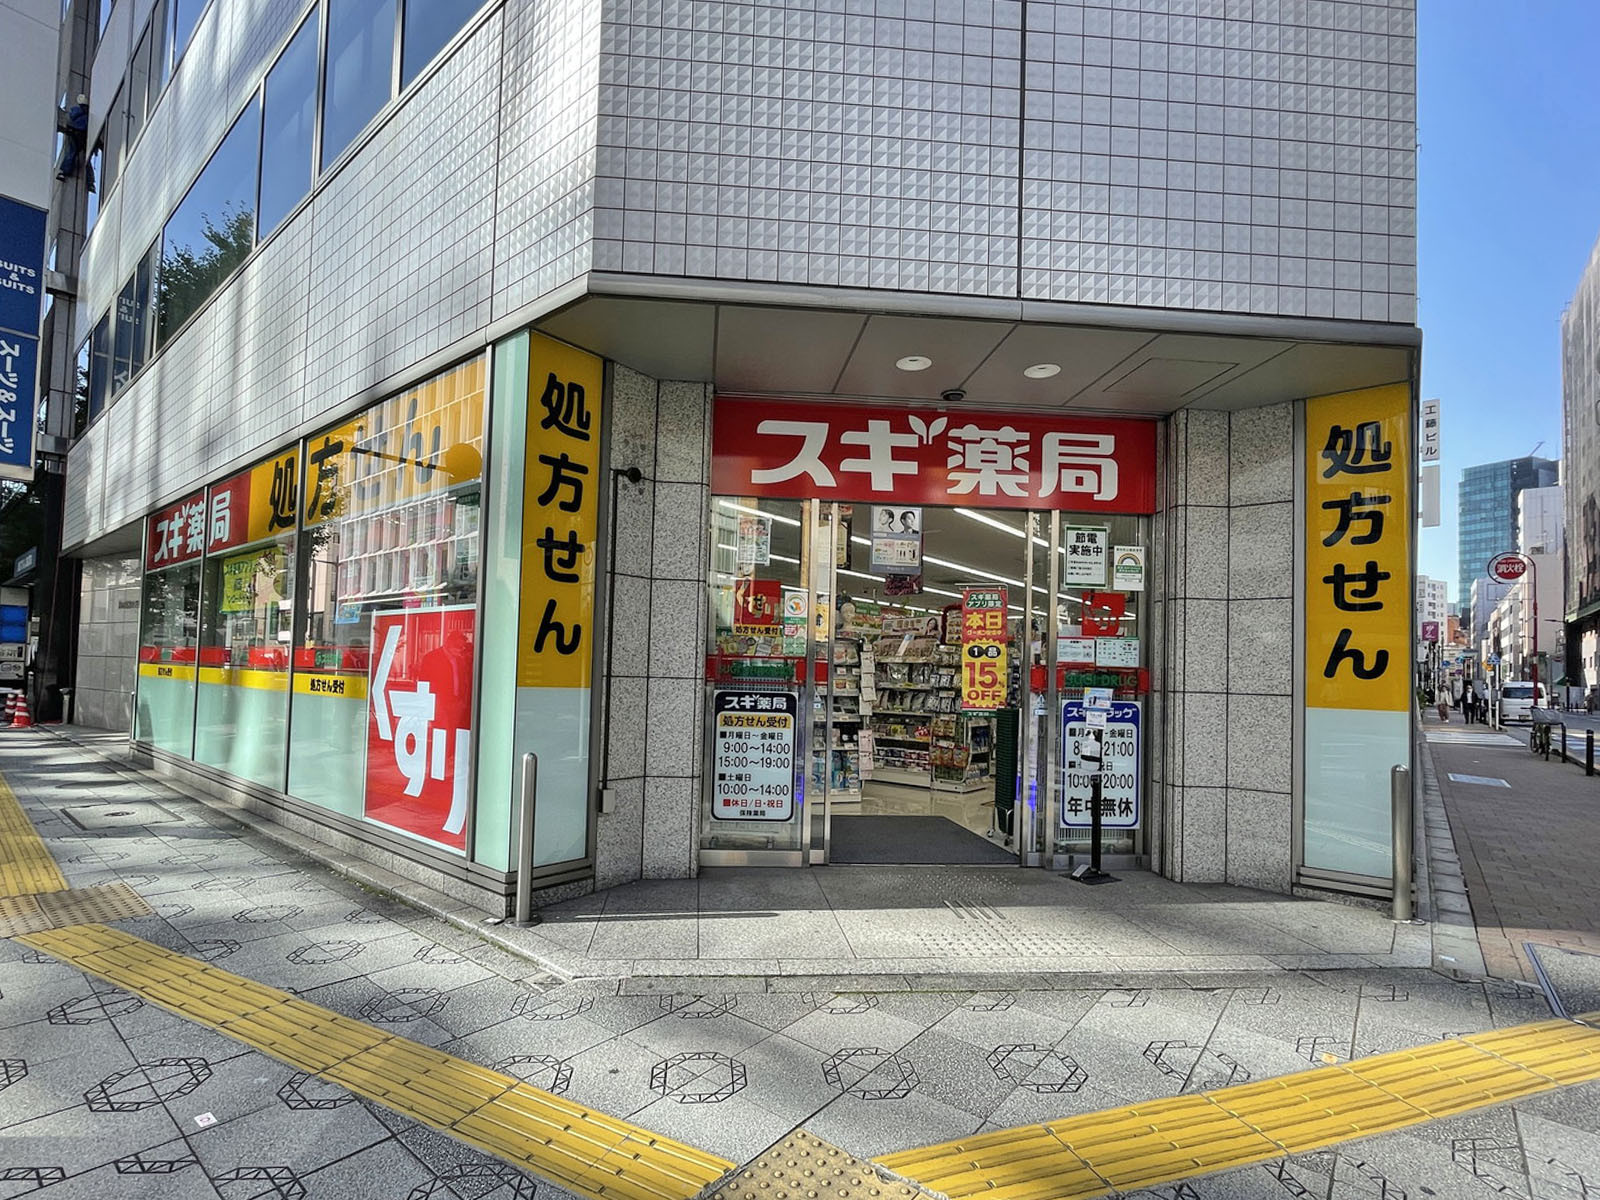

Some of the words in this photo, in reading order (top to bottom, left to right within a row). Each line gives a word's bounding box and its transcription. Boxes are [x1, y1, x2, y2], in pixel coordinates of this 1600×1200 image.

[9, 272, 20, 281] &
[0, 278, 35, 294] UITS
[751, 414, 1118, 501] スギ薬局
[533, 371, 591, 657] 処方せん
[154, 490, 231, 563] スギ薬局
[1075, 532, 1098, 544] 節電
[1069, 545, 1103, 557] 実施中
[1321, 420, 1392, 681] 処方せん
[966, 611, 1002, 629] 本日
[724, 694, 787, 710] スギ薬局
[967, 689, 1002, 701] OFF
[371, 624, 471, 835] くすり
[722, 716, 788, 728] 処方せん受付
